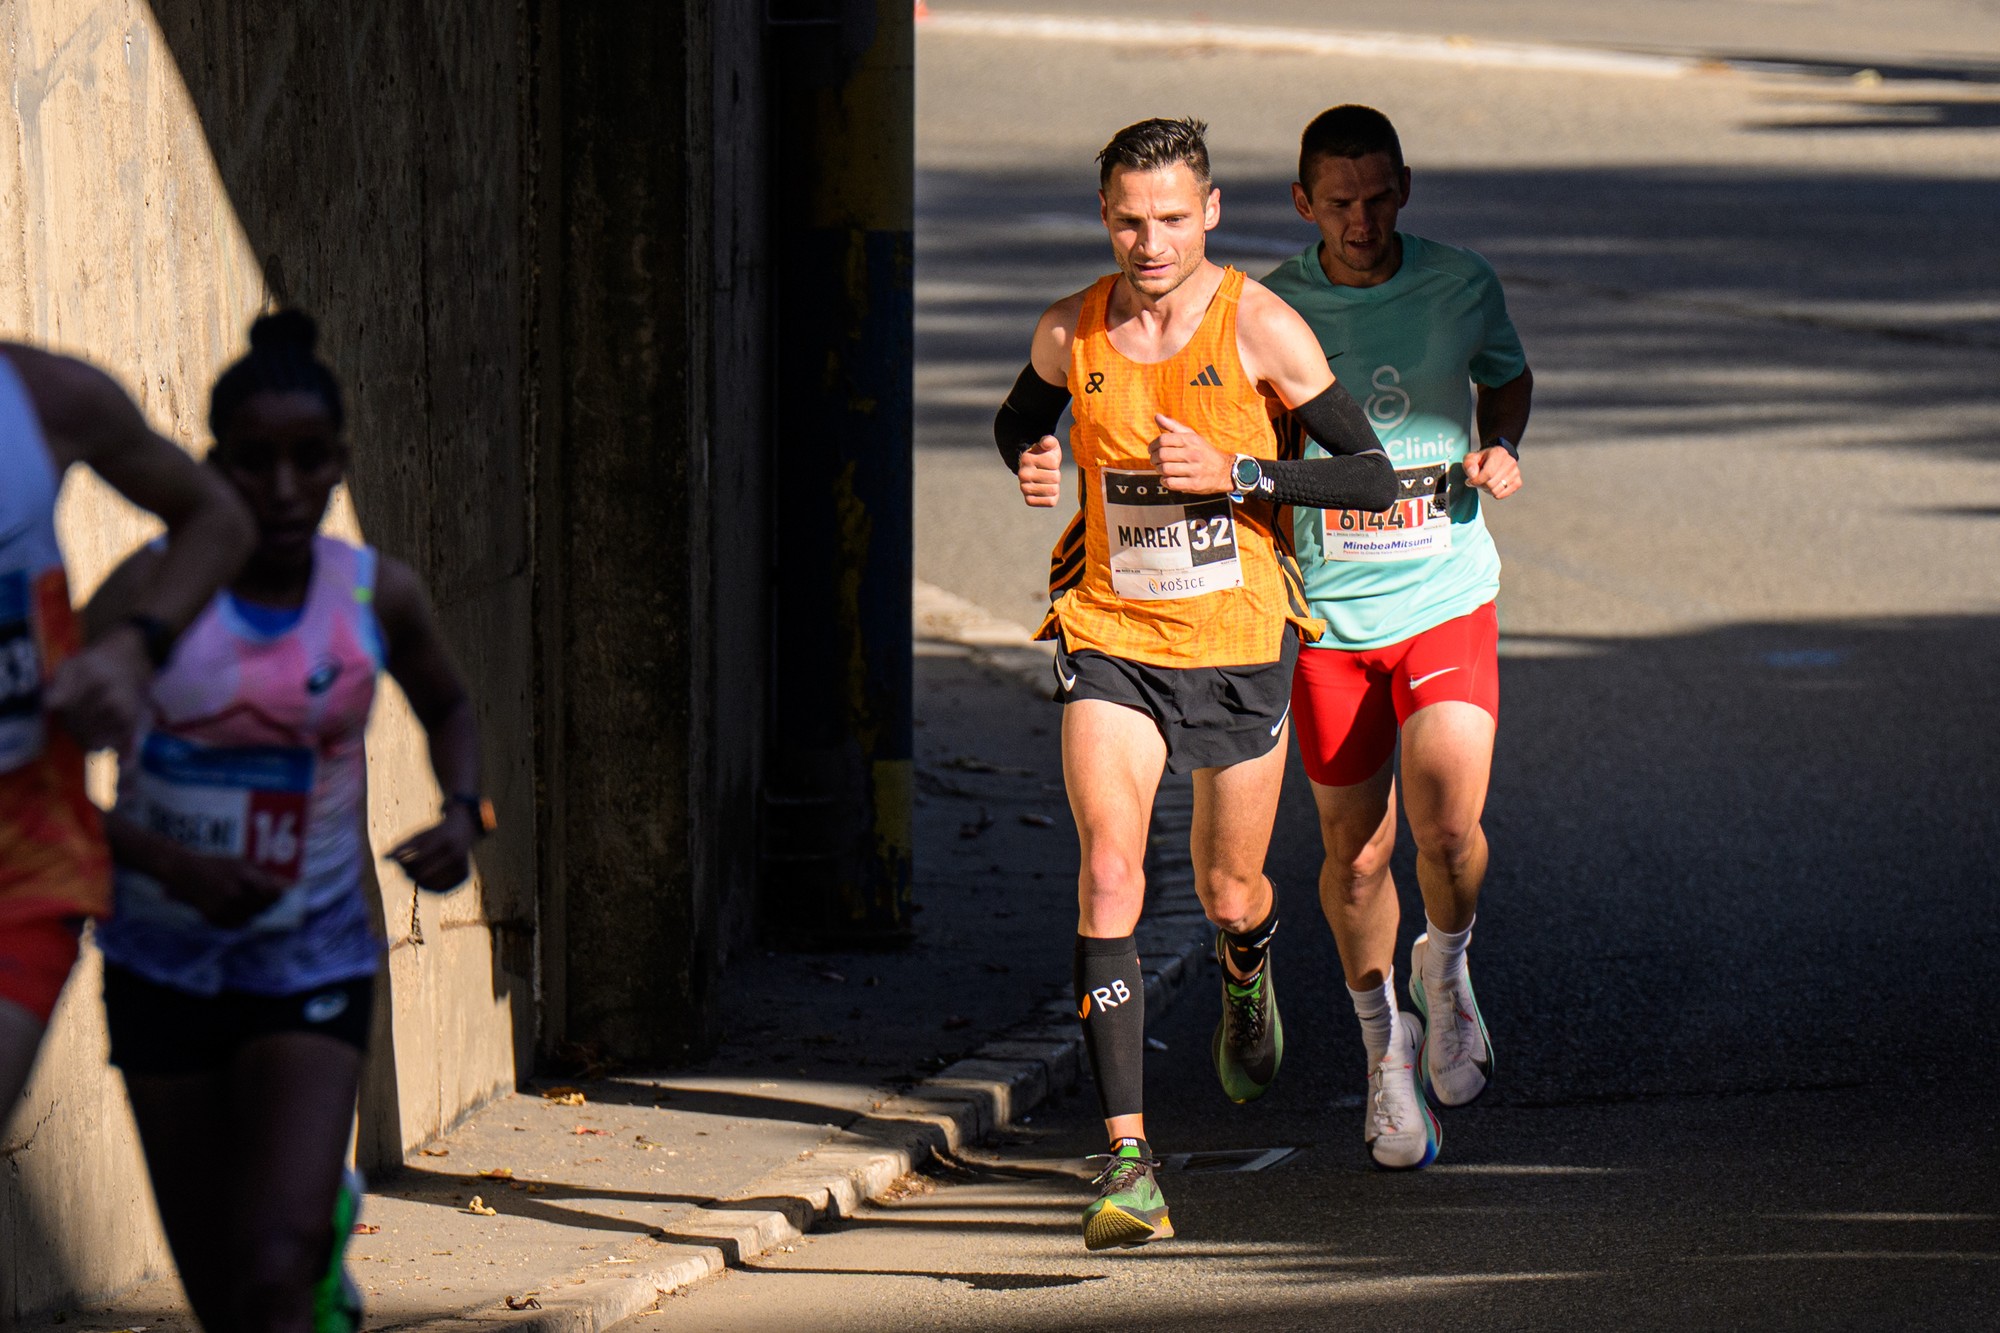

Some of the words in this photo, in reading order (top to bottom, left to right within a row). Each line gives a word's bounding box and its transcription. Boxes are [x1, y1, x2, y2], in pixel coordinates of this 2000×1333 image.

[1385, 433, 1455, 461] Clinic
[1118, 525, 1181, 548] MAREK
[1190, 514, 1232, 551] 32
[1343, 535, 1432, 551] MinebeaMitsumi
[1160, 577, 1205, 592] KOŠICE
[255, 812, 298, 865] 16
[1092, 979, 1131, 1012] RB
